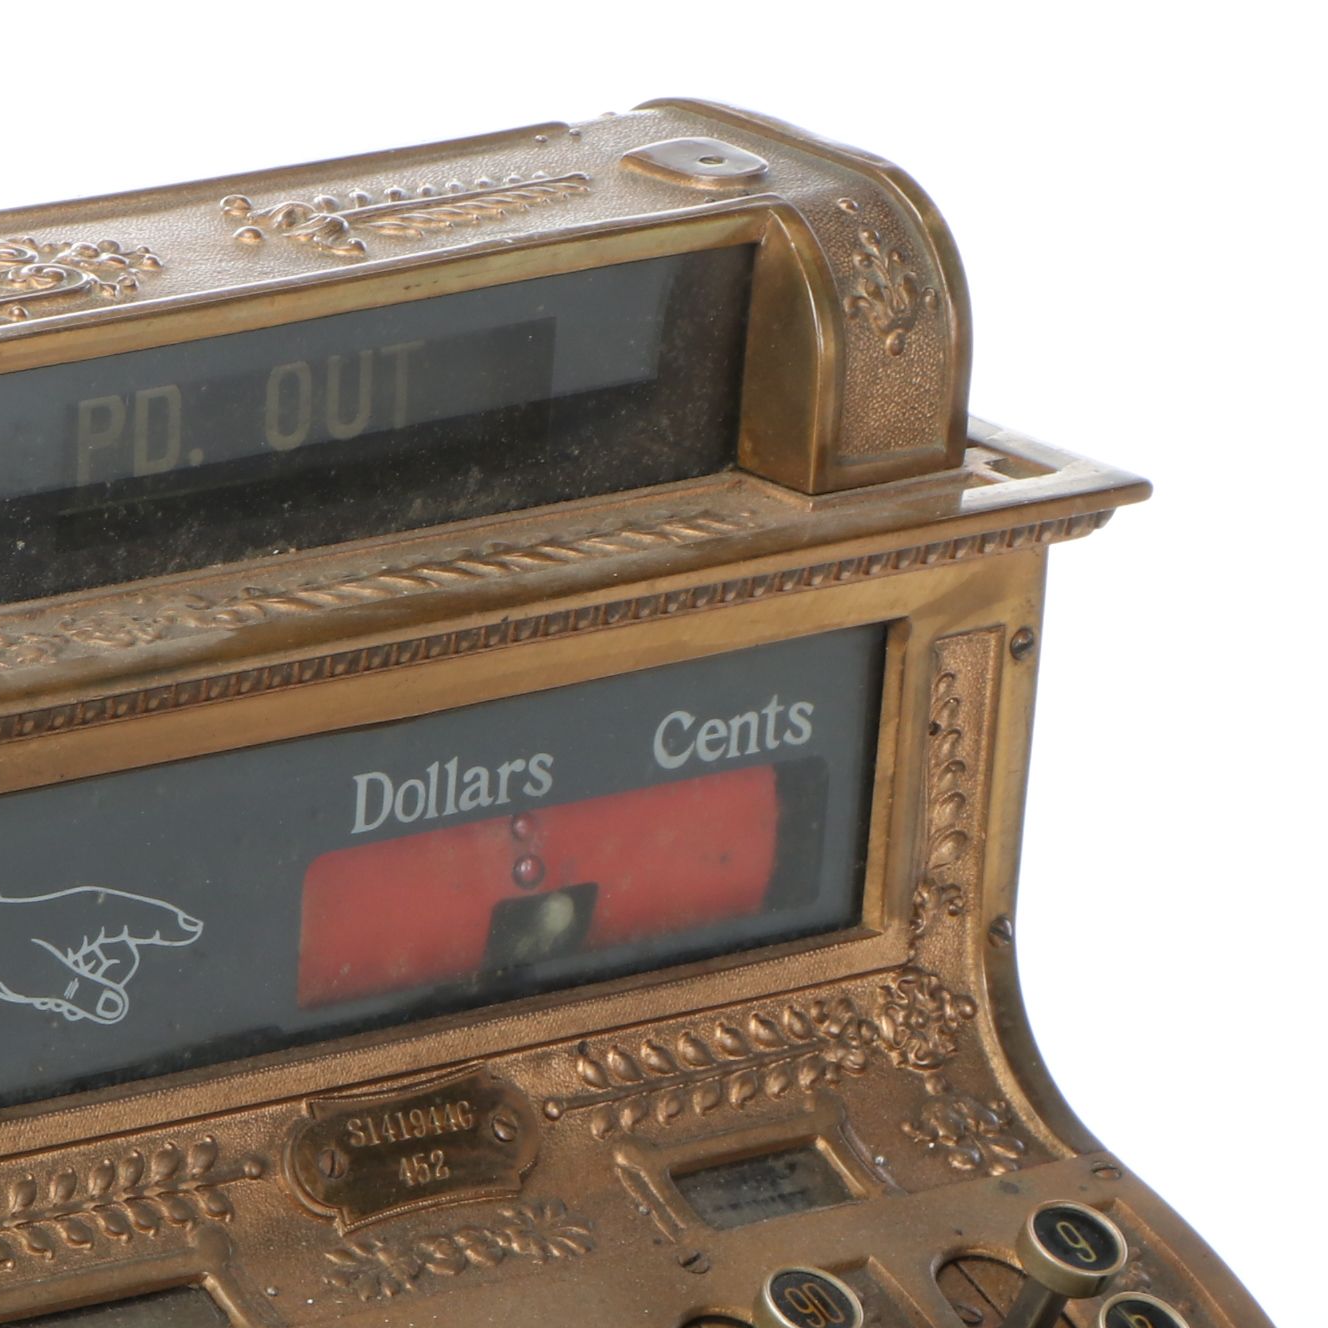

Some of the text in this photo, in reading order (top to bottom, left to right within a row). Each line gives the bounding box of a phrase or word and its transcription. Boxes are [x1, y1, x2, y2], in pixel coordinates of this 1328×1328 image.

[76, 340, 427, 484] PD. OUT
[652, 694, 815, 770] Cents
[350, 752, 554, 835] Dollars
[398, 1149, 450, 1187] 452
[1056, 1221, 1097, 1263] 9
